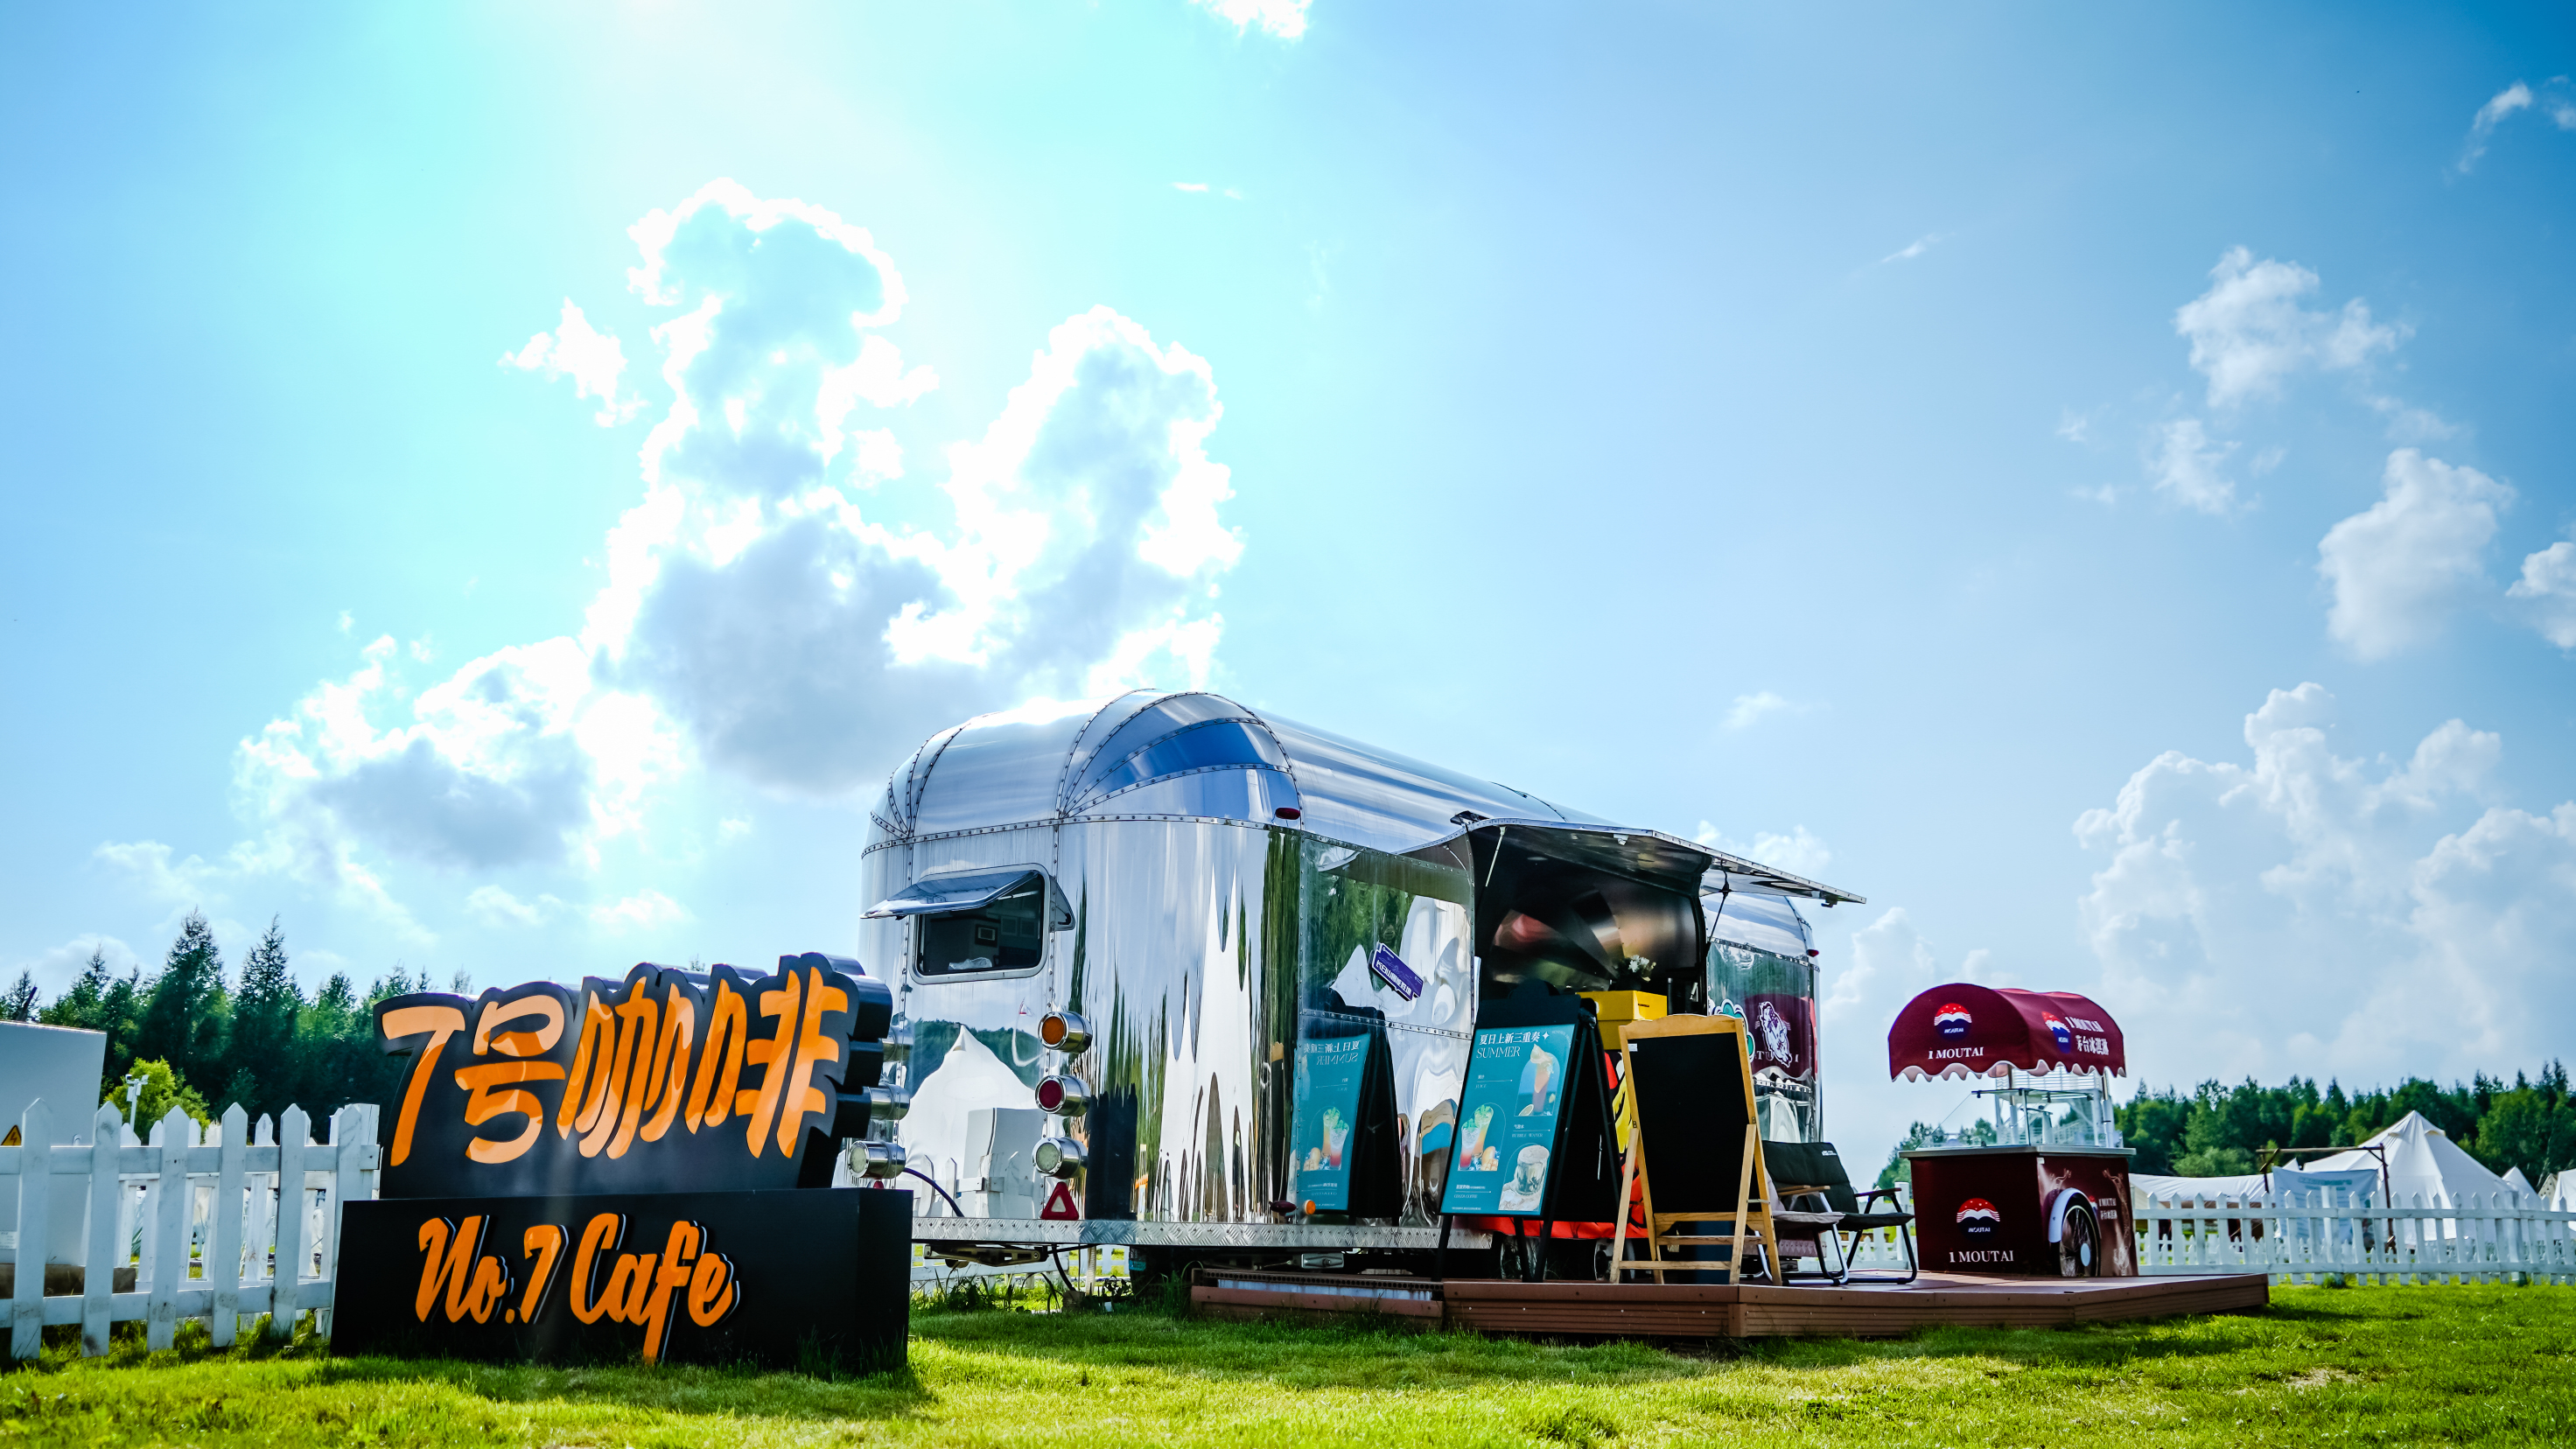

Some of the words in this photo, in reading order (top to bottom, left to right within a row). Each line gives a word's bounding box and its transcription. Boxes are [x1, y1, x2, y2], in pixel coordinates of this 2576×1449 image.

[2069, 1017, 2104, 1032] MOUTAI
[1479, 1031, 1541, 1046] 夏日上新三重奏
[1476, 1046, 1521, 1059] SUMMER
[1936, 1046, 1984, 1060] MOUTAI
[381, 966, 848, 1166] 7号咖啡
[1958, 1250, 2014, 1263] MOUTAI
[415, 1214, 568, 1325] No.7
[569, 1212, 739, 1365] Cafe
